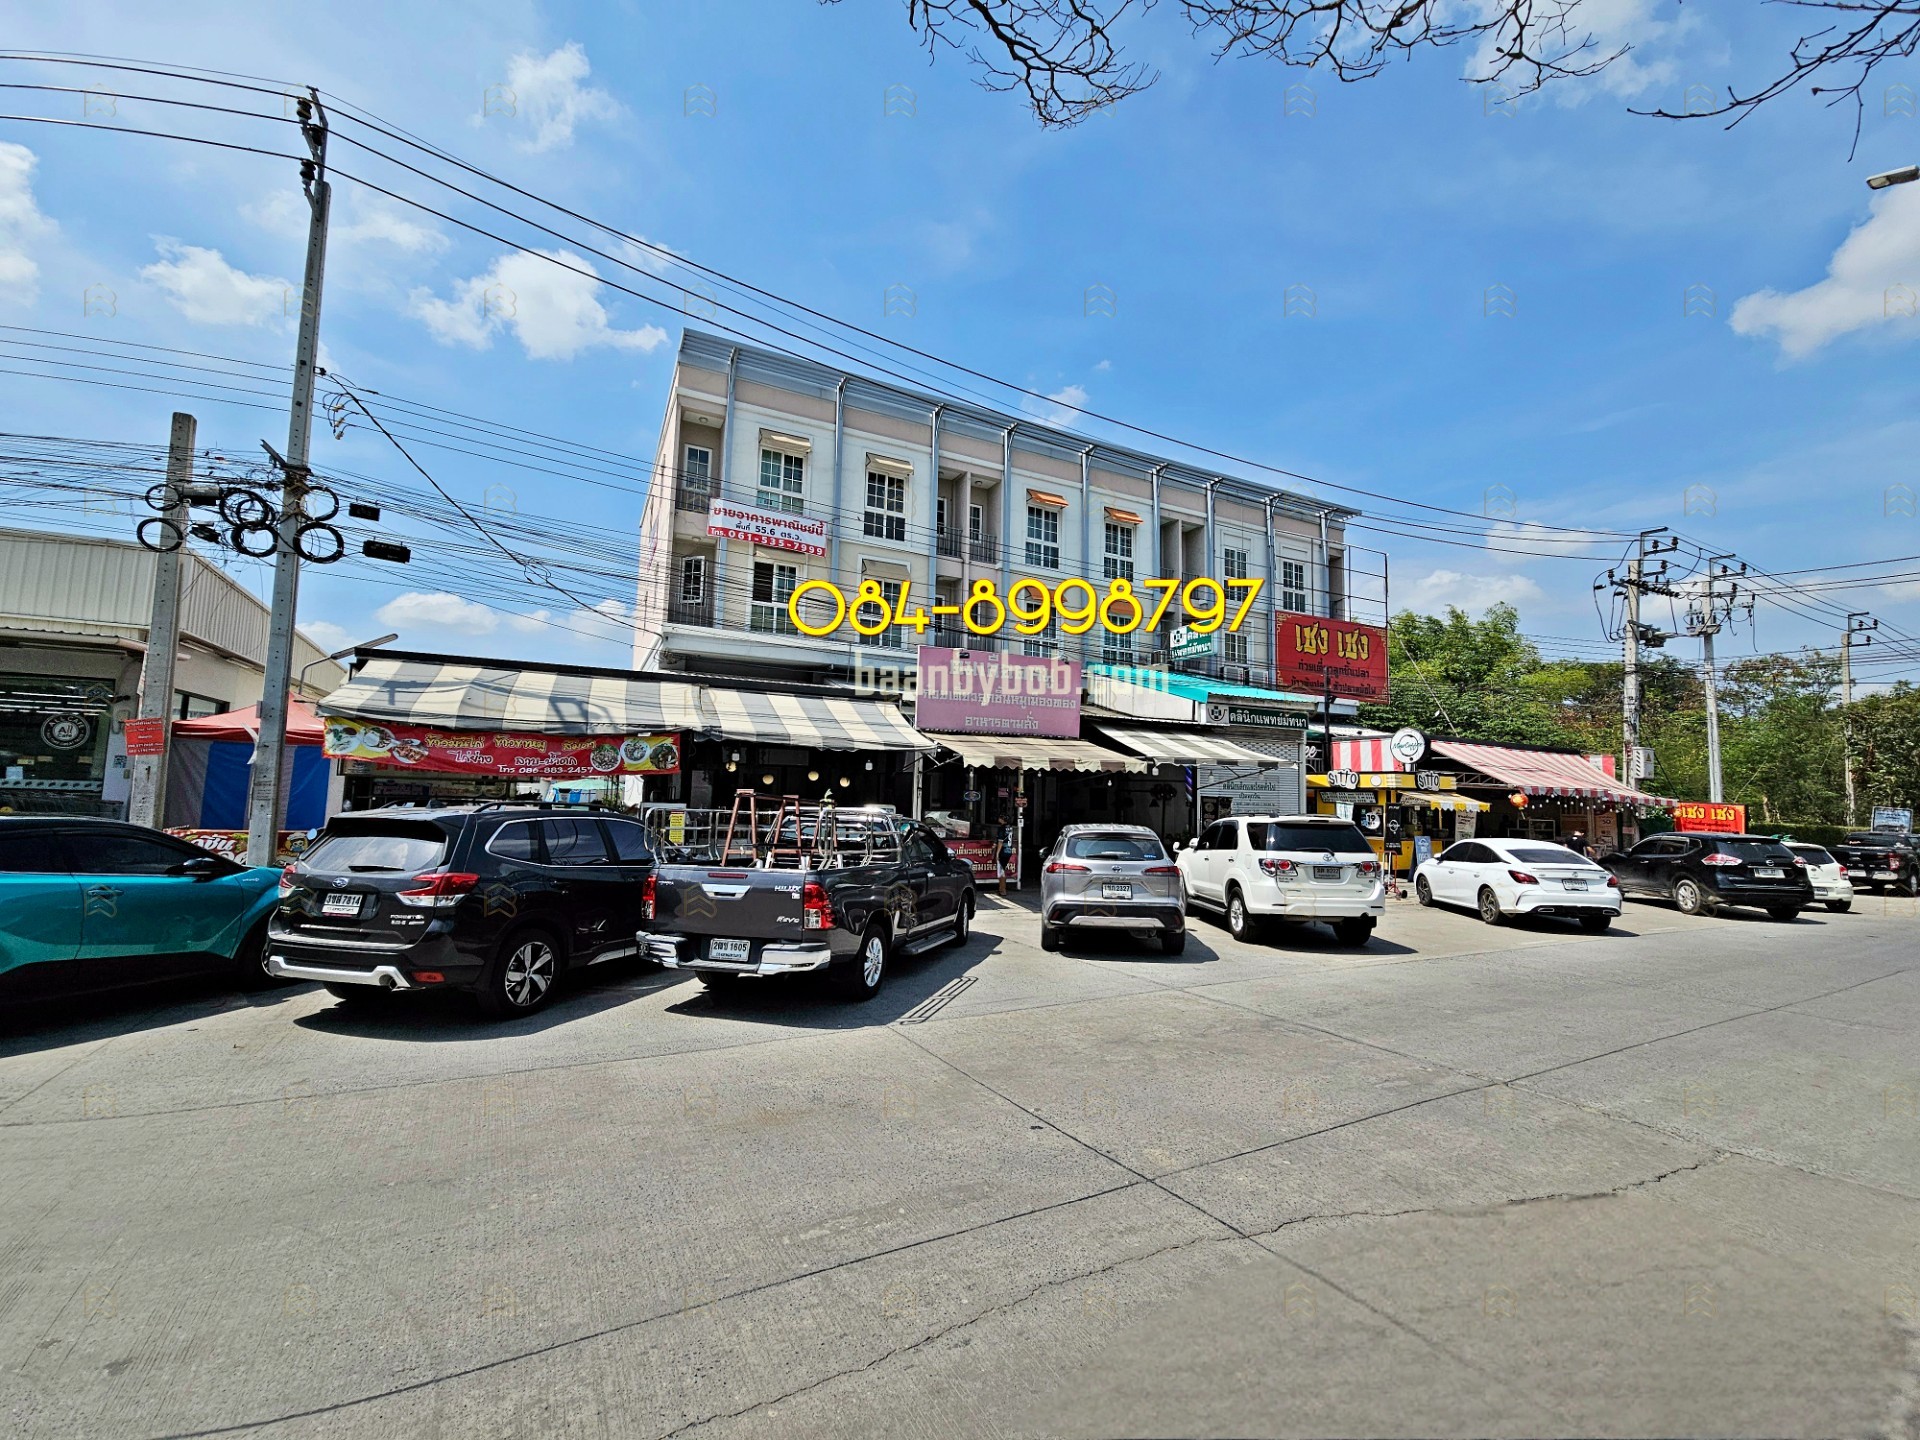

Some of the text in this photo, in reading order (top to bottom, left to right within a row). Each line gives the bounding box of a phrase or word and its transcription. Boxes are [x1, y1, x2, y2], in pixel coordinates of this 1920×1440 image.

[713, 506, 824, 537] ขายอาคารพาณิชย์นี้
[735, 521, 803, 541] พื้นที่ 55.6 ตร.ว.
[710, 527, 823, 556] โทร. 061-535-7999
[965, 711, 1039, 730] อาหารตามสั่ง
[1230, 710, 1307, 727] คลินิกแพทย์มัทนา
[58, 725, 73, 734] All
[493, 734, 548, 753] ข้าวขาหมู
[447, 750, 578, 766] ไก่ย่าง ลาบ-น้ำตก
[497, 764, 594, 774] โทร 086-883-2457
[1366, 814, 1376, 822] 19
[342, 895, 361, 906] 7814
[730, 943, 747, 952] 1605
